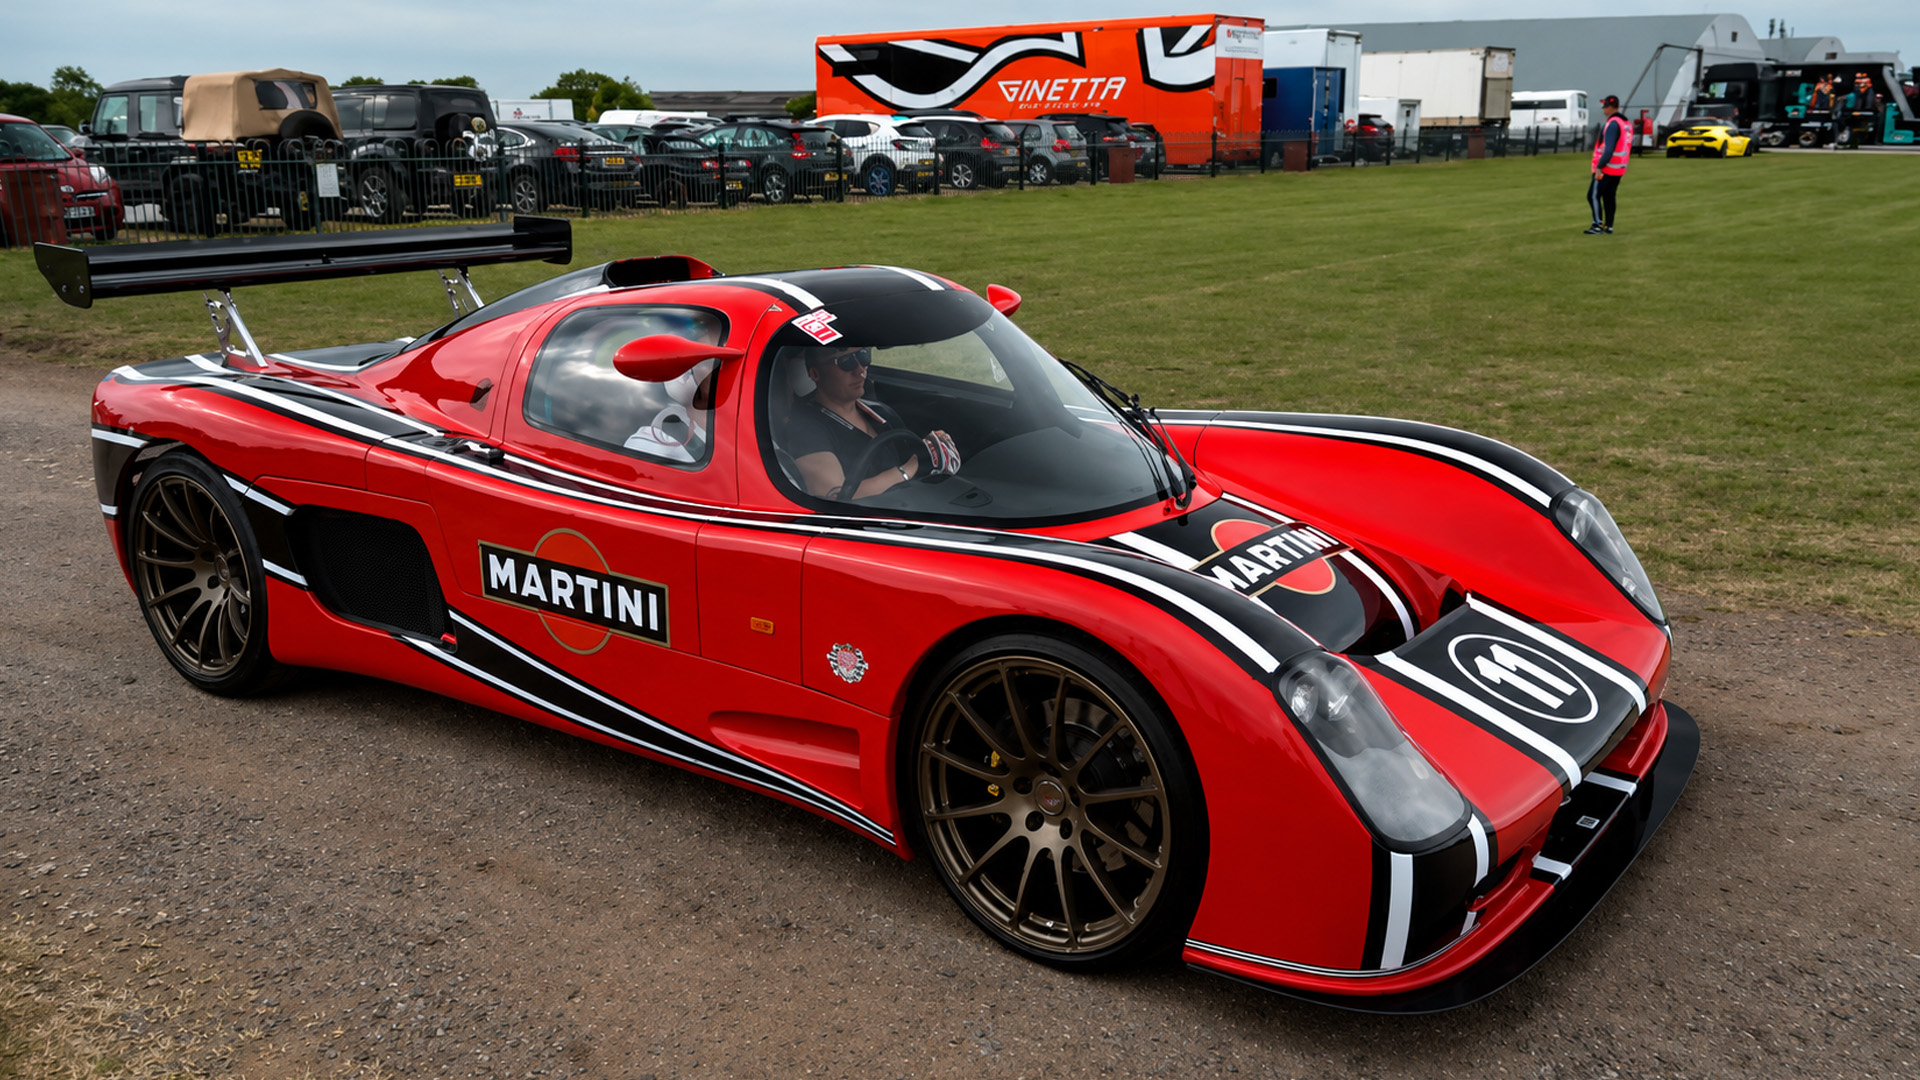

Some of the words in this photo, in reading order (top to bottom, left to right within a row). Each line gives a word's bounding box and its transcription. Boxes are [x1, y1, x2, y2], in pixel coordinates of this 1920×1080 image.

[997, 76, 1127, 103] GINETTA
[1199, 526, 1340, 590] MARTINI
[488, 553, 659, 632] MARTINI
[1473, 643, 1578, 710] 11
